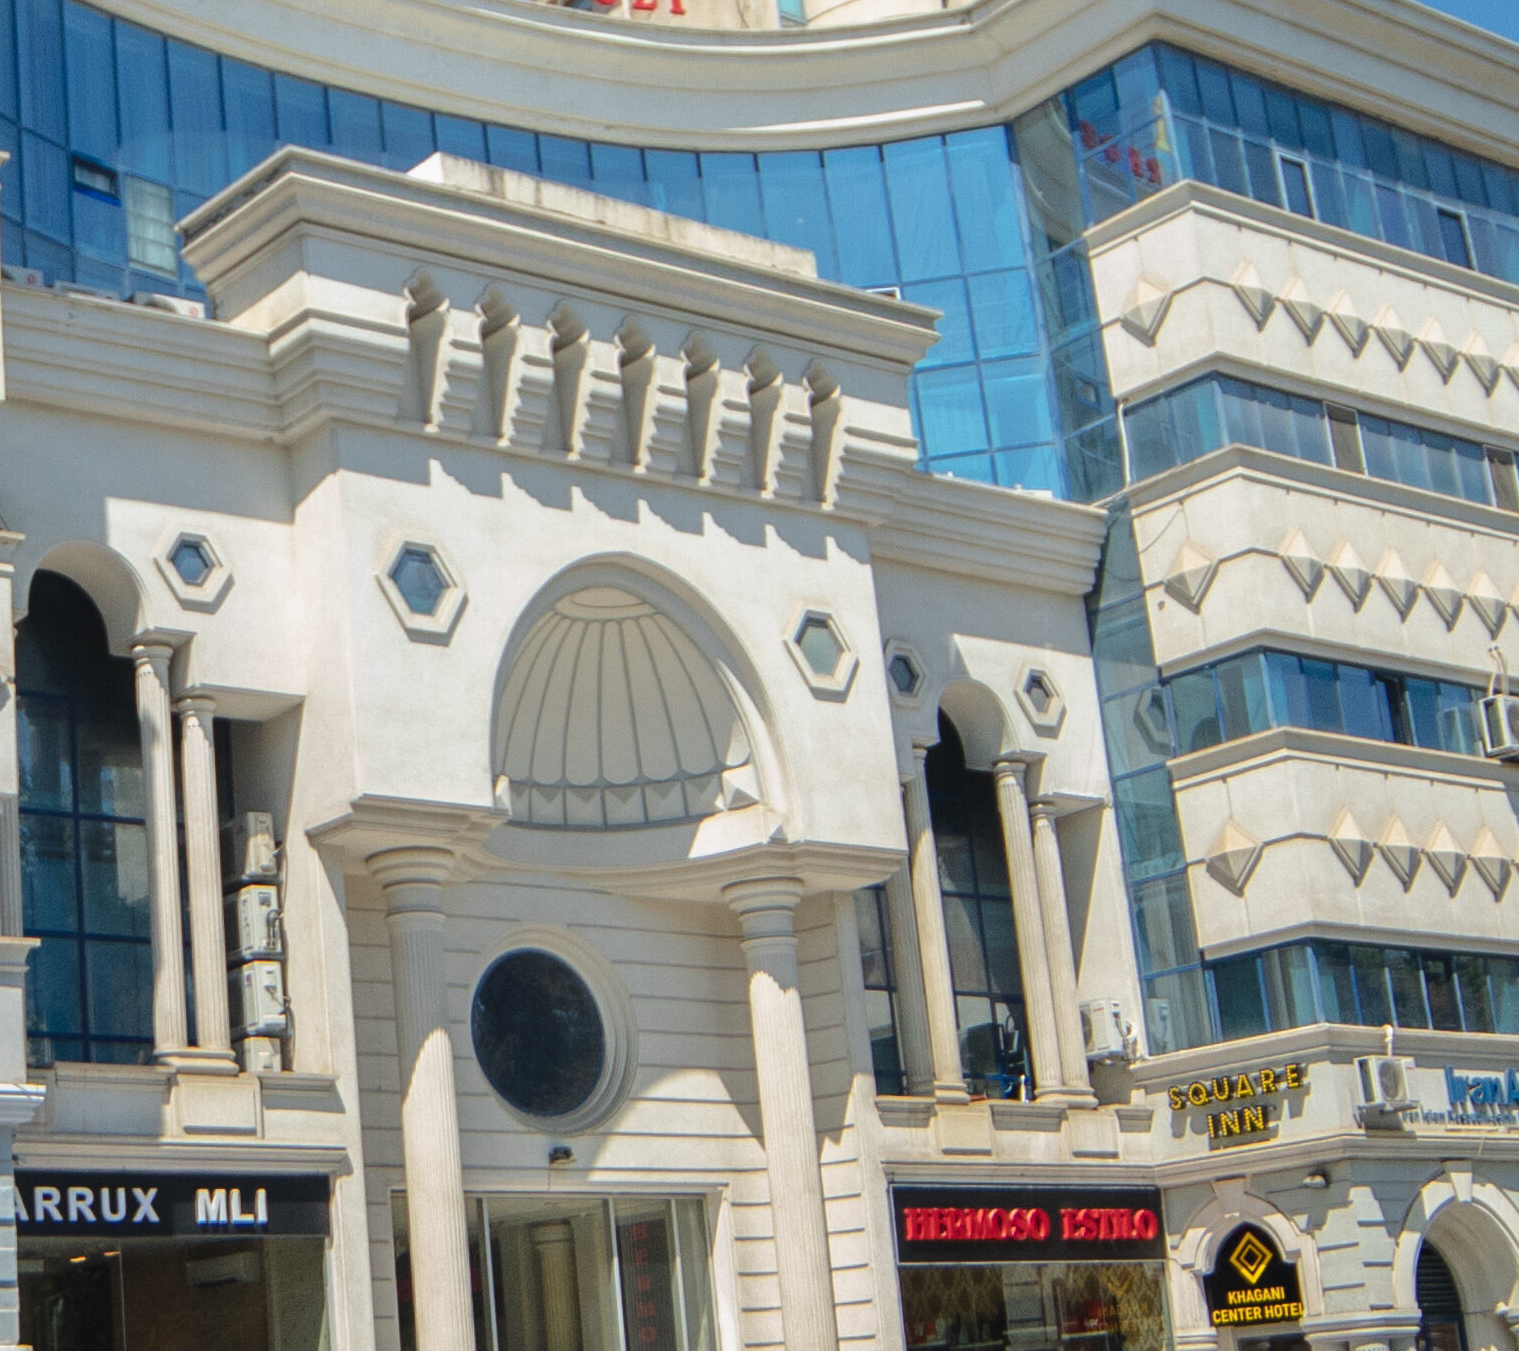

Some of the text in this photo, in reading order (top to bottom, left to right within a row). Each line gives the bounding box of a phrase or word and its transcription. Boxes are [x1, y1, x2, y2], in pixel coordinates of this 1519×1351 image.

[1168, 1063, 1300, 1111] SQUARE
[1207, 1106, 1267, 1139] INN
[194, 1188, 269, 1226] MLI
[1228, 1287, 1286, 1305] KHAGANI
[1212, 1302, 1305, 1324] CENTER HOTEL
